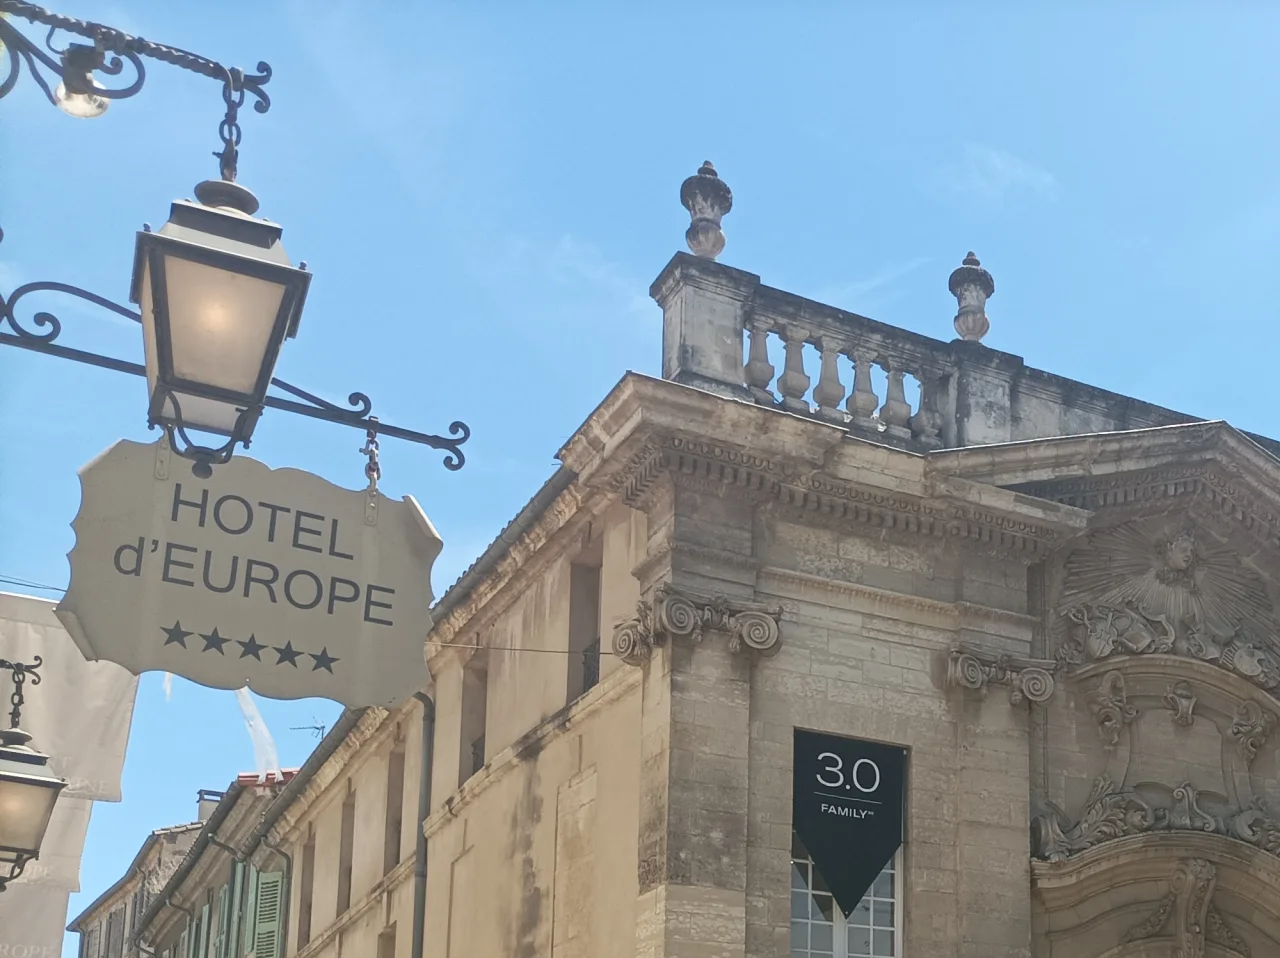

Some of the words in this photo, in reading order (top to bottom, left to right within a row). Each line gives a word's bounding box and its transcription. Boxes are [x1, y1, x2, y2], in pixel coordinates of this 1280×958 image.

[171, 483, 354, 561] HOTEL
[113, 536, 396, 627] d'EUROPE
[816, 752, 880, 793] 3.0
